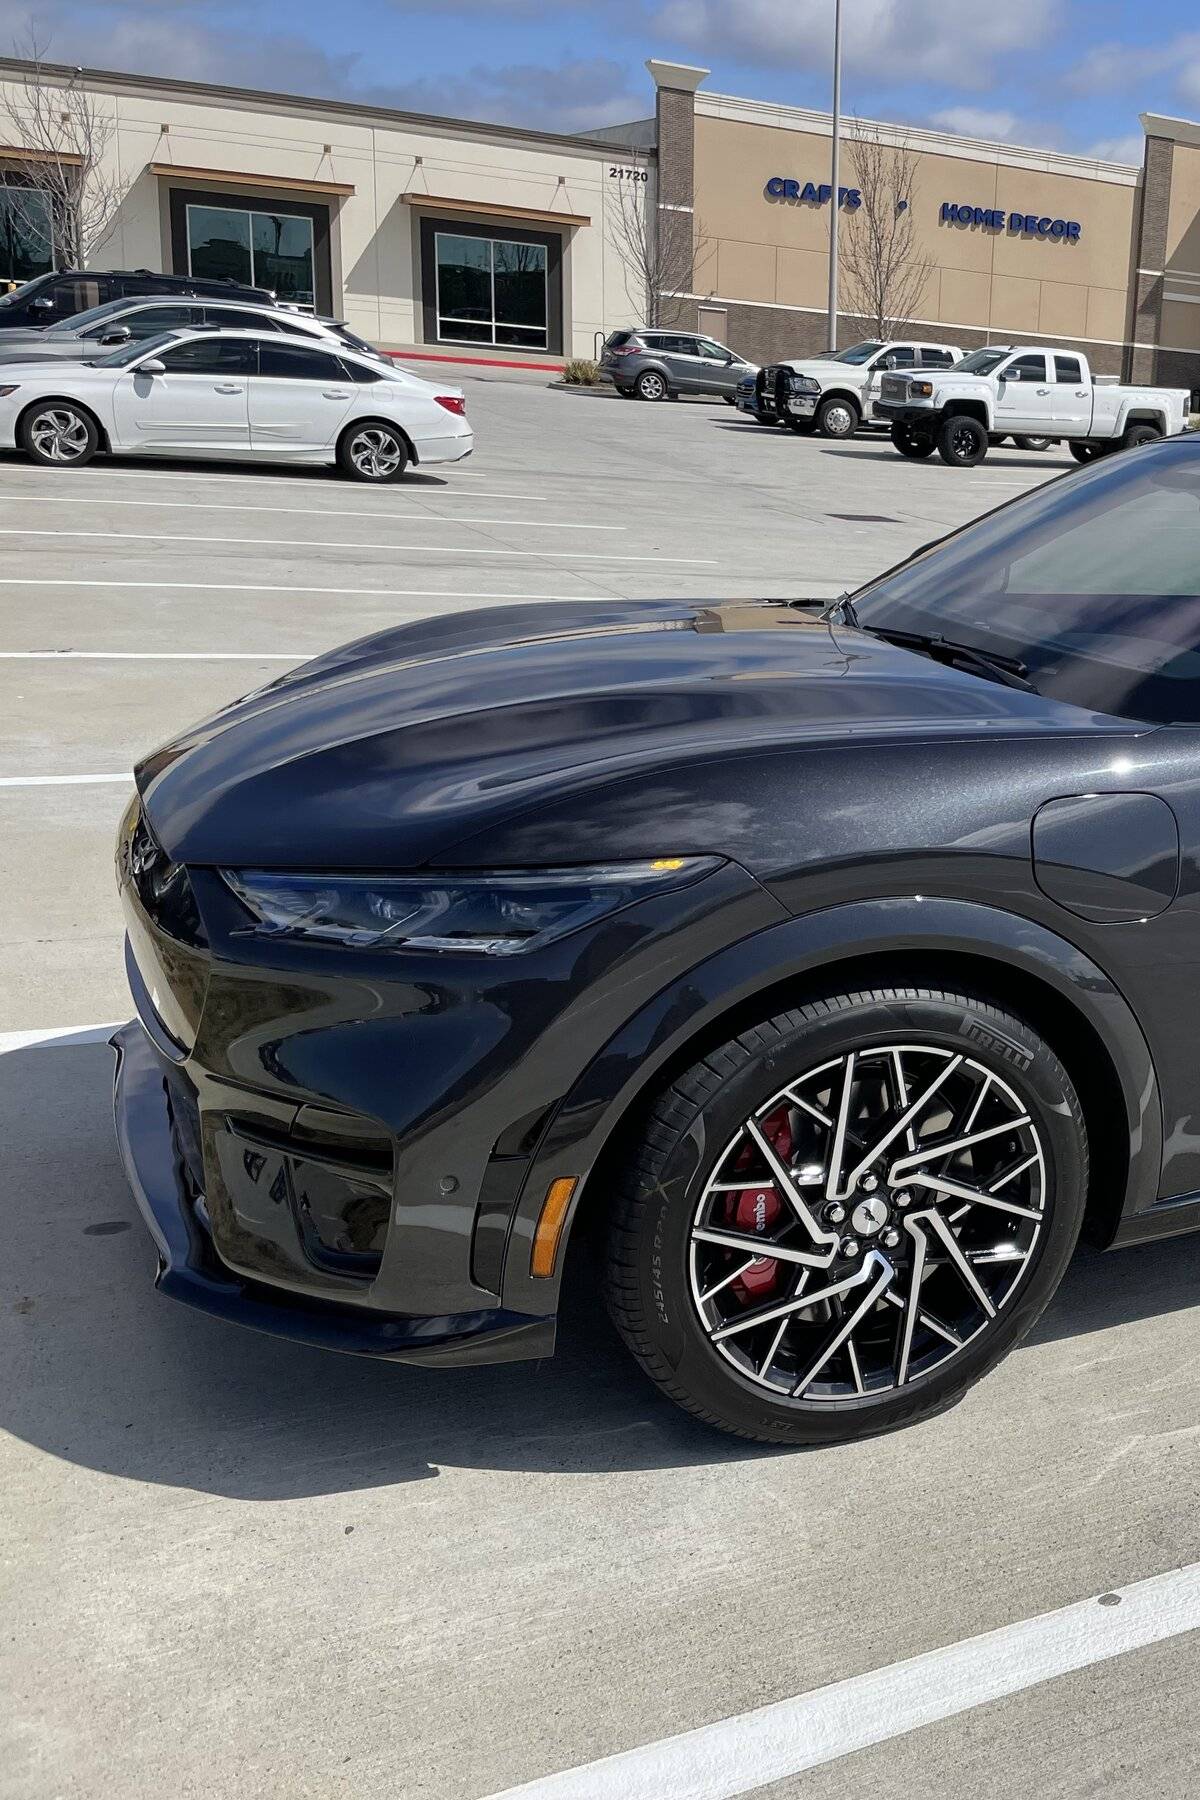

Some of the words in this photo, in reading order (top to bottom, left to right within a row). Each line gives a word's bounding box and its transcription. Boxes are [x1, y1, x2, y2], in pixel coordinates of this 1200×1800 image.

[609, 168, 648, 182] 21720
[767, 177, 862, 208] CRAFTS
[942, 203, 1006, 229] HOME
[1010, 213, 1081, 240] DECOR
[959, 1013, 1034, 1072] PIRELLI
[753, 1193, 766, 1232] embo
